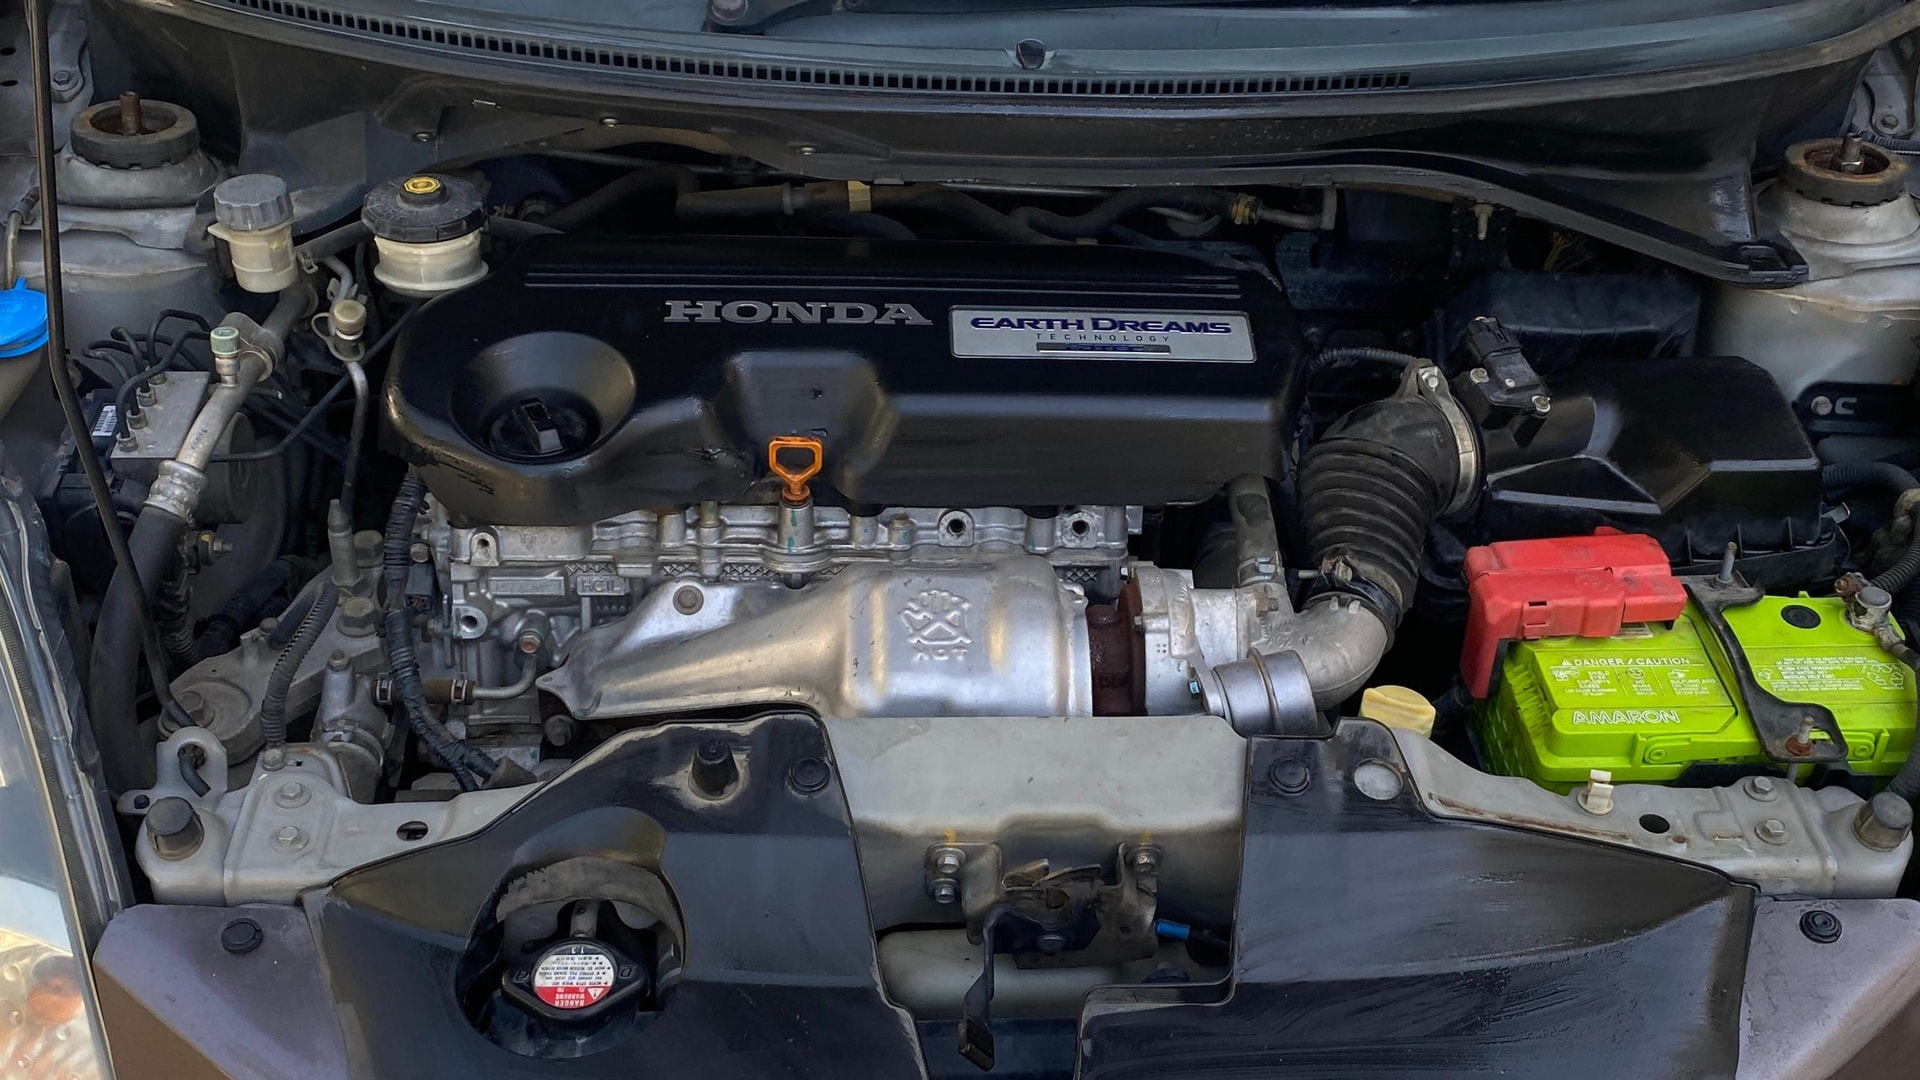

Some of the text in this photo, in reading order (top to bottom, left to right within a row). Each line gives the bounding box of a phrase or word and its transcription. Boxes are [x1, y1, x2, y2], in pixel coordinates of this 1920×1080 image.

[663, 300, 933, 326] HONDA
[970, 316, 1232, 334] EARTH DREAMS
[1036, 333, 1170, 343] TECHNOLOGY
[1574, 658, 1624, 666] DANGER
[1637, 657, 1691, 665] CAUTION
[1573, 709, 1681, 725] AMARON
